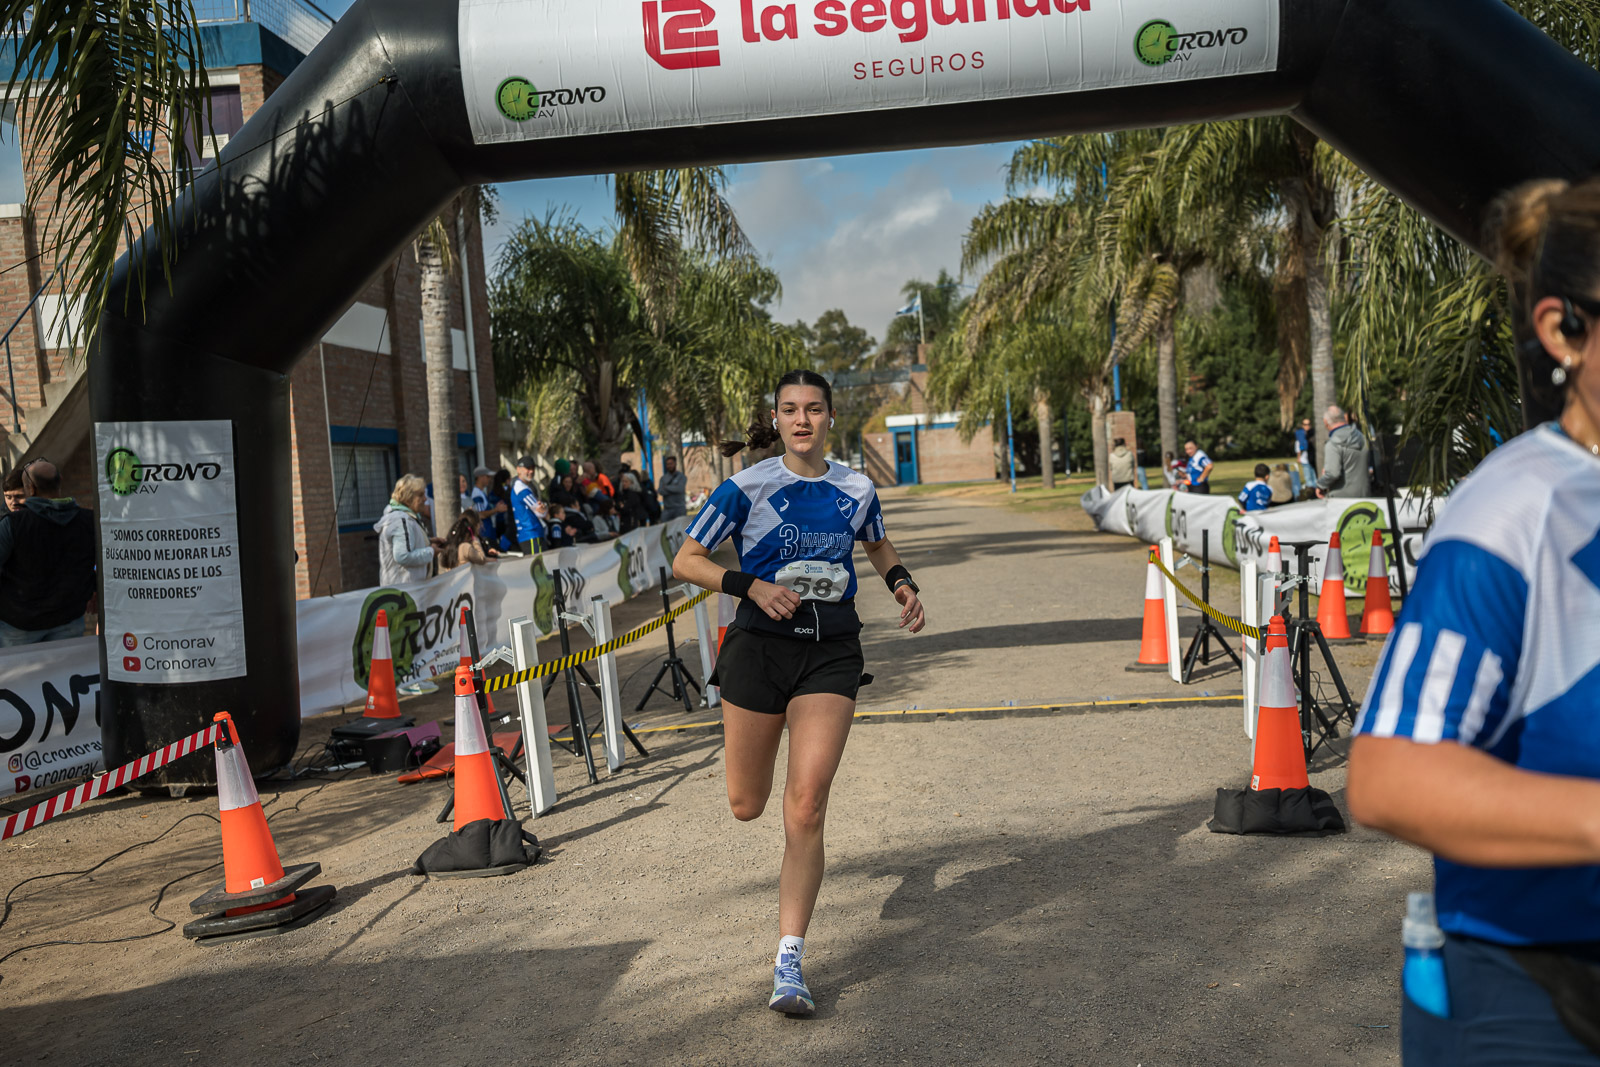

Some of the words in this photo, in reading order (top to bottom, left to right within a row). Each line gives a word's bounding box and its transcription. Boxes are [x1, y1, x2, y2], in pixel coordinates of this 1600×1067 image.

[740, 0, 798, 43] la
[1166, 27, 1248, 50] CRONO
[853, 51, 985, 80] SEGUROS
[1164, 52, 1193, 64] RAV
[526, 86, 606, 108] CRONO
[527, 108, 556, 120] RAV
[130, 462, 221, 482] CRONO
[129, 484, 159, 494] RAV
[146, 527, 221, 541] CORREDORES
[779, 523, 799, 560] 3
[105, 547, 151, 561] BUSCANDO
[154, 547, 208, 561] MEJORAR
[211, 545, 232, 558] LAS
[112, 567, 181, 580] EXPERIENCIAS
[183, 567, 199, 579] DE
[201, 565, 222, 578] LOS
[792, 576, 833, 598] 58
[143, 636, 216, 650] Cronorav
[144, 657, 217, 671] Cronorav
[34, 761, 98, 789] cronorav
